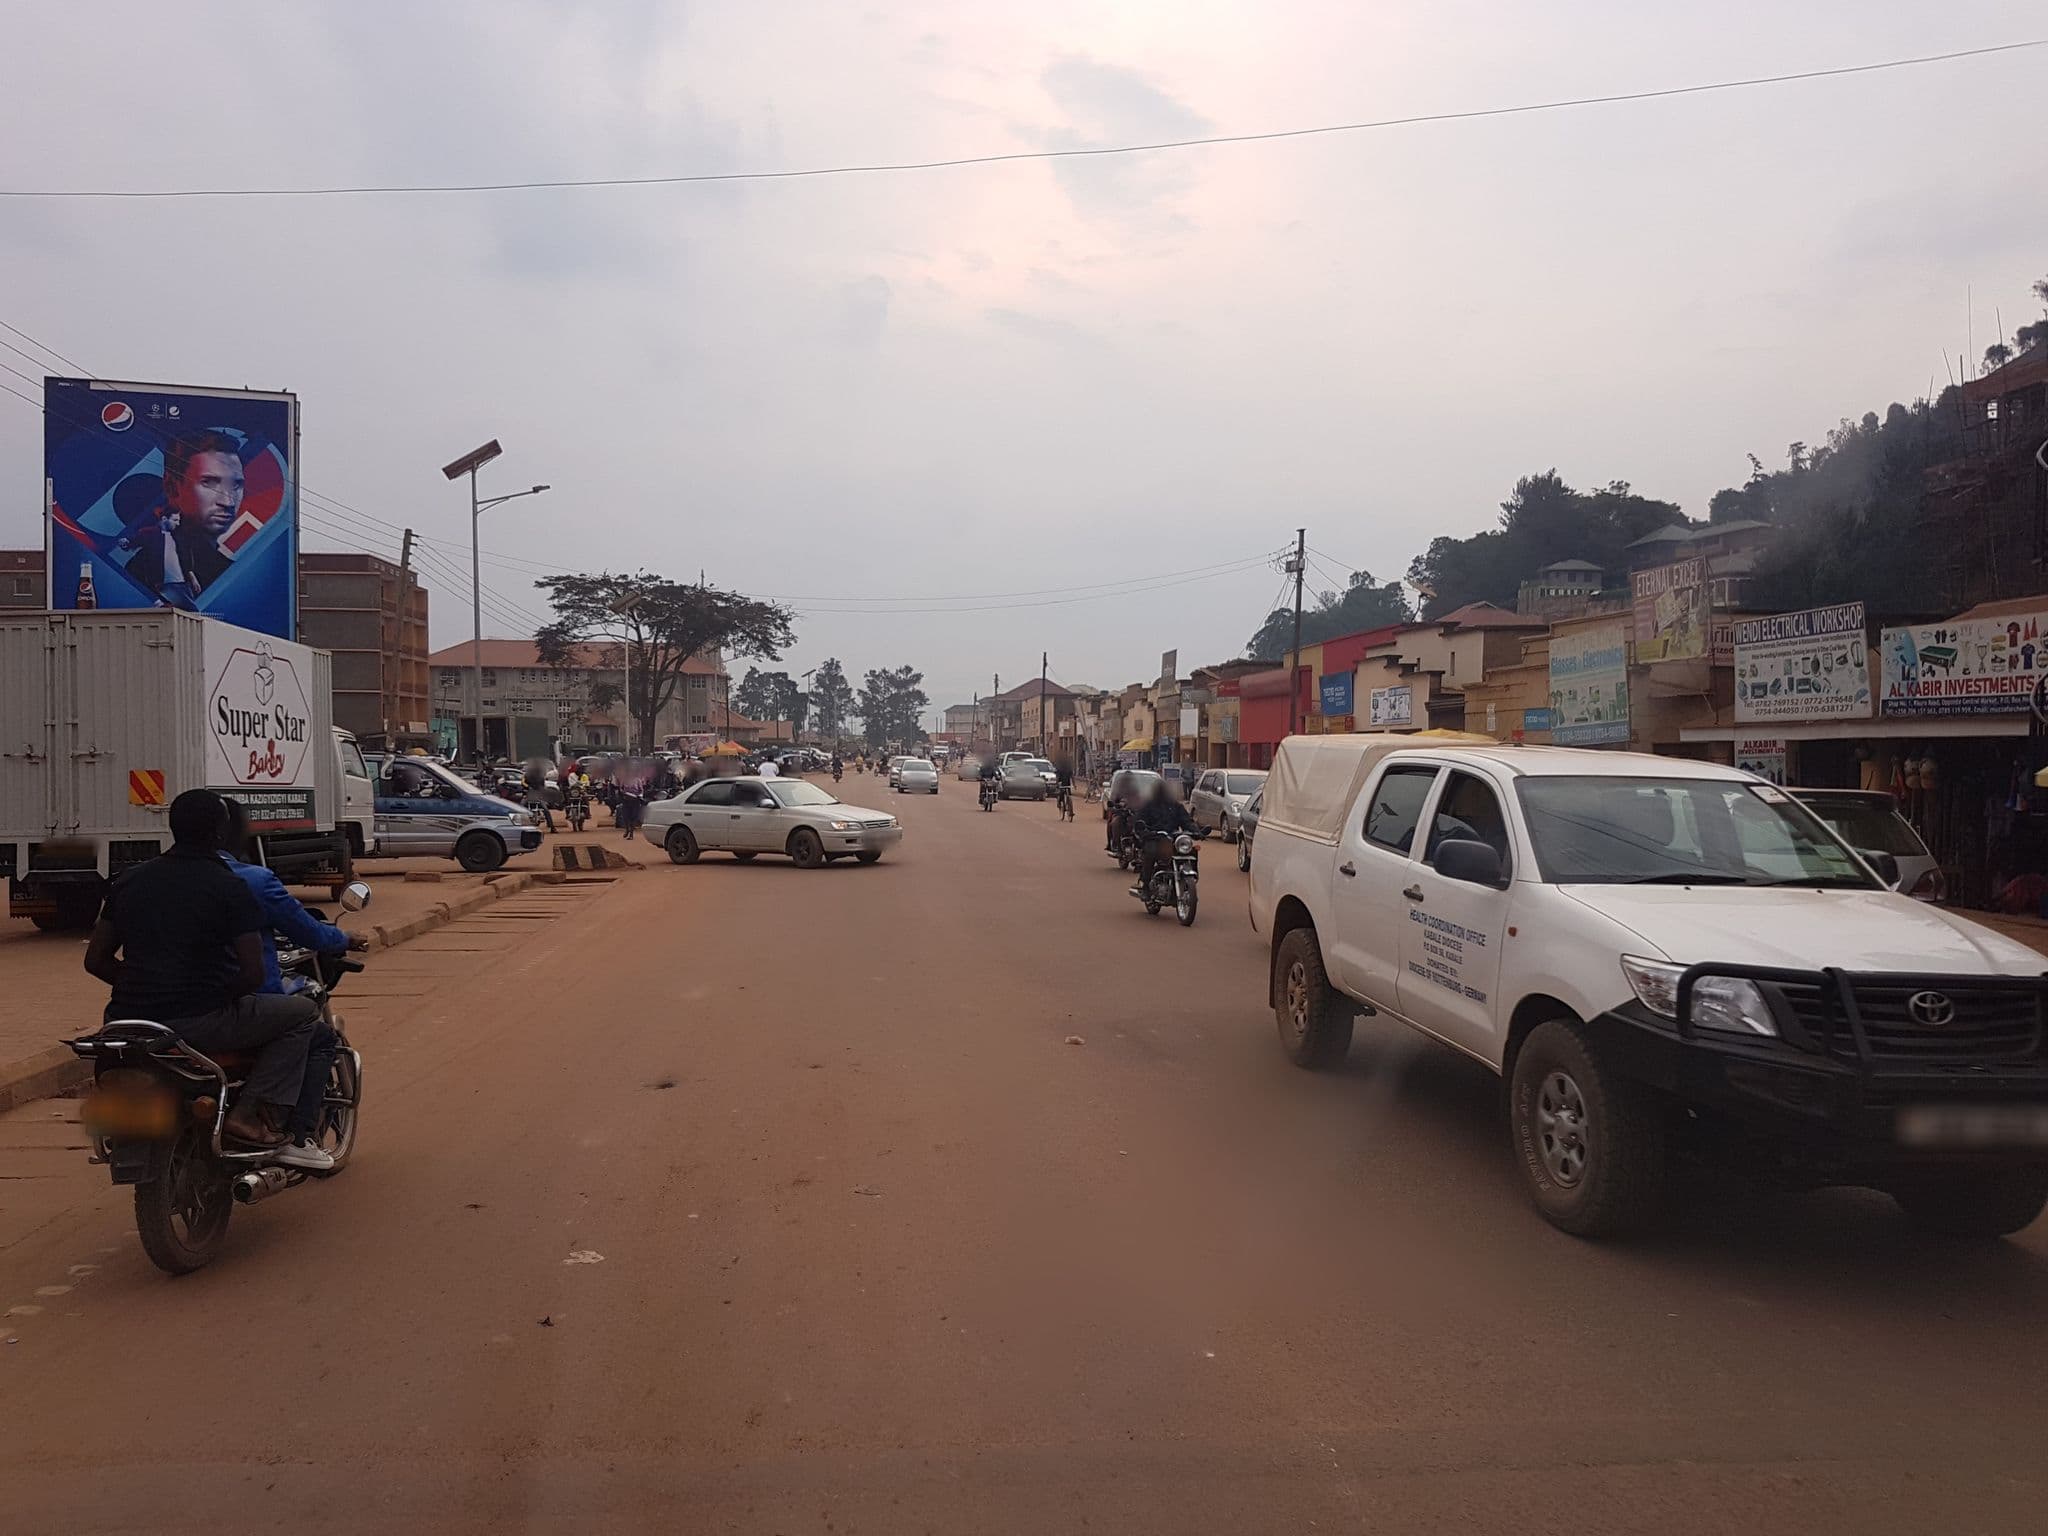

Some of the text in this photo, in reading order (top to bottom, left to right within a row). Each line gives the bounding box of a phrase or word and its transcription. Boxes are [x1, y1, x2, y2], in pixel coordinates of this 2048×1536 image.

[1637, 560, 1702, 597] ETERNAL EXCEL
[1735, 605, 1863, 643] WENDI ELECTRICAL WORKSHOP
[1889, 683, 1905, 698] AL
[1907, 681, 1942, 697] KABIR
[1945, 676, 2035, 695] INVESTMENTS
[217, 696, 306, 748] Super Star
[1744, 740, 1777, 748] ALKABIR
[1410, 908, 1487, 947] HEALTH COORDINATION OFFICE
[1424, 929, 1463, 952] KABALE DIOCESE
[1408, 960, 1426, 977] DIOCESE
[1464, 985, 1487, 1004] GERMANY
[1427, 957, 1449, 974] DONATED
